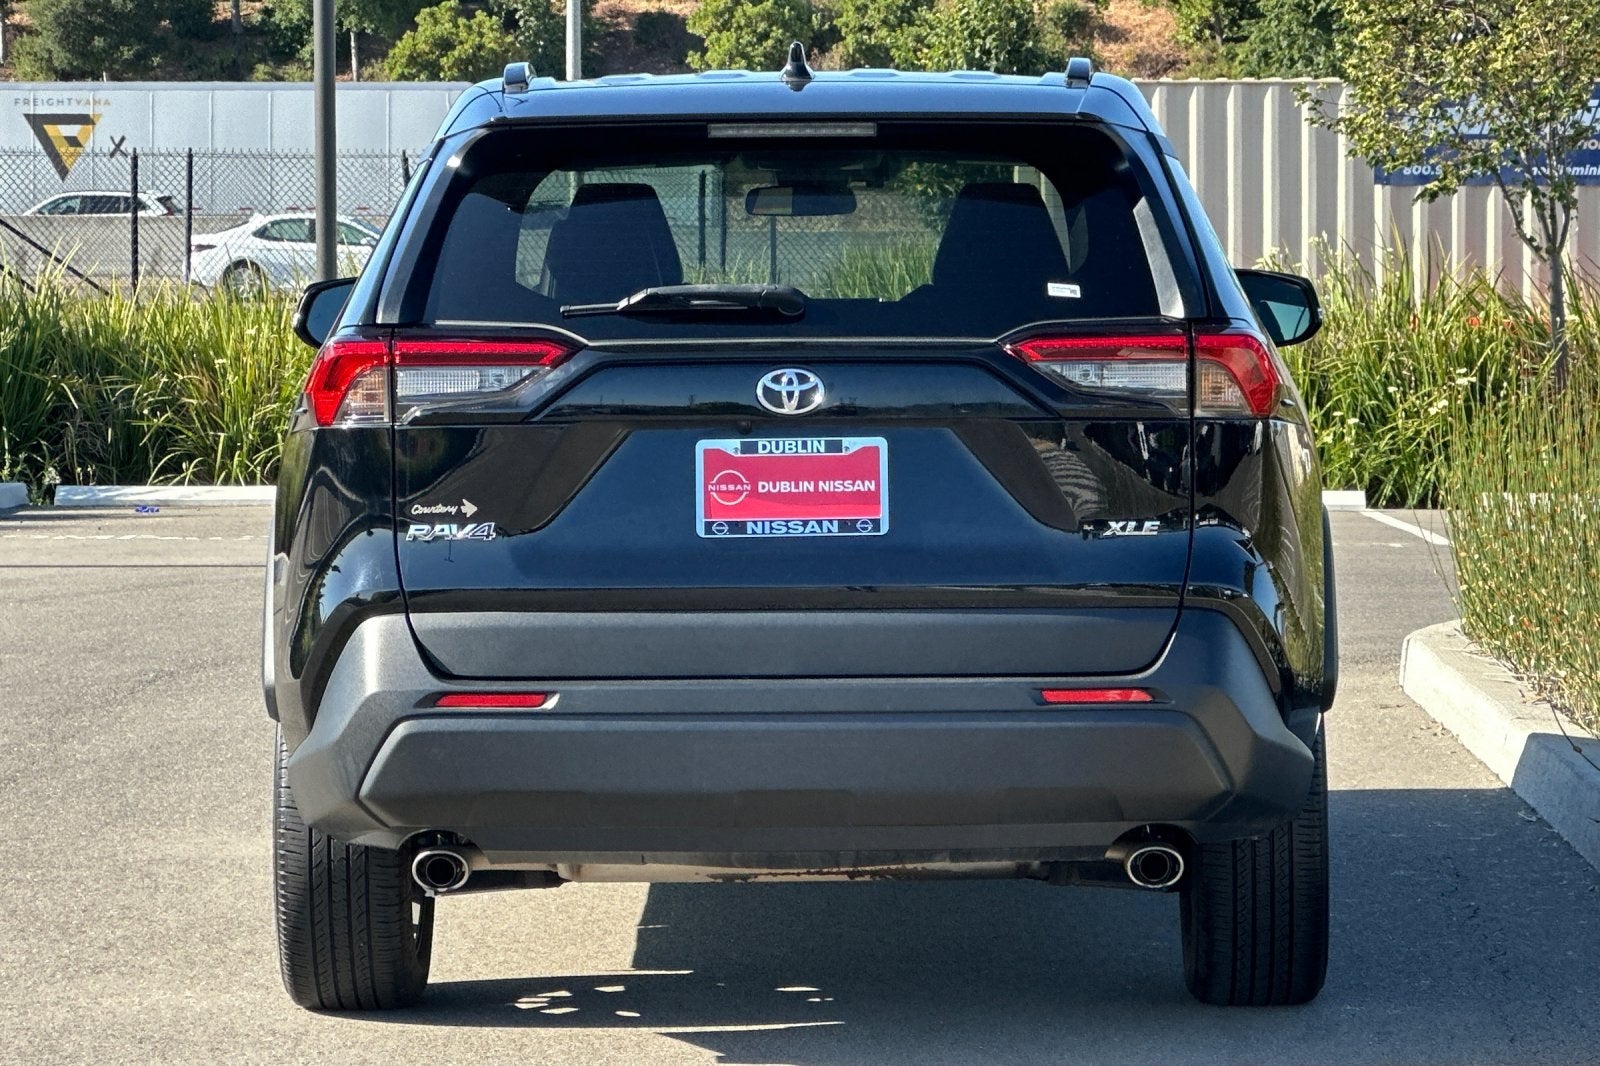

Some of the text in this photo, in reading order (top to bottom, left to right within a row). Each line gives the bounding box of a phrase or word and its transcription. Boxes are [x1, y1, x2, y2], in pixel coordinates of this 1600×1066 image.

[757, 440, 825, 454] DUBLIN
[757, 480, 876, 493] DUBLIN NISSAN
[405, 522, 496, 541] RAV4
[746, 520, 839, 535] NISSAN
[1102, 520, 1161, 536] XLE
